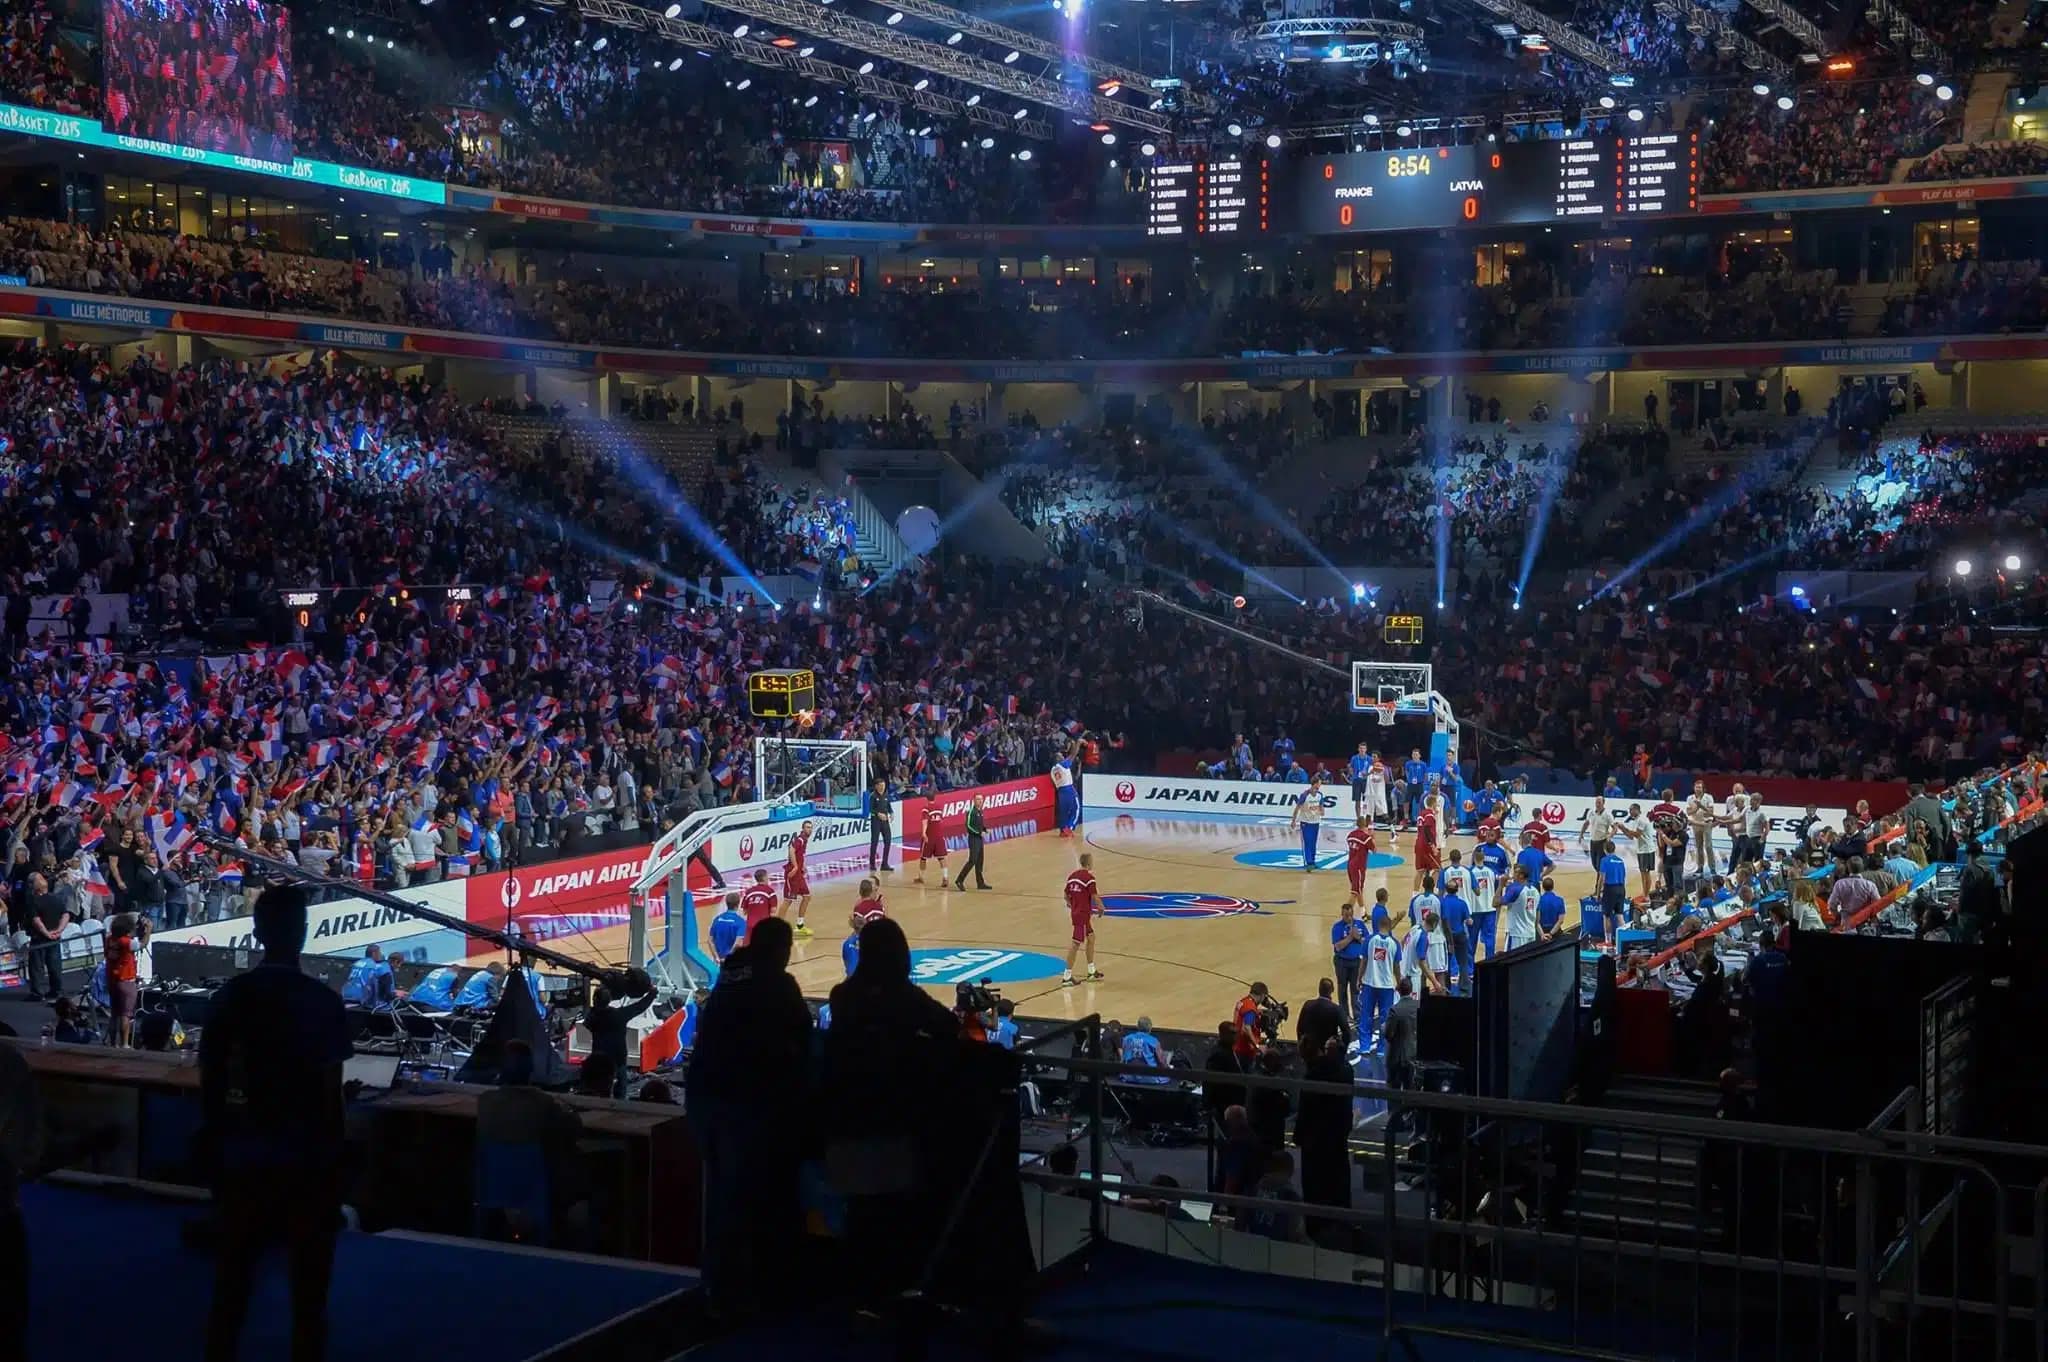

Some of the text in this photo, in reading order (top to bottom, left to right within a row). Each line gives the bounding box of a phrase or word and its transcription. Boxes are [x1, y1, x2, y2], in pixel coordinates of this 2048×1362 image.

[54, 117, 80, 137] 2015
[292, 162, 313, 177] 2015
[1388, 155, 1430, 177] 8:54
[1492, 155, 1500, 168] 0
[1325, 165, 1333, 178] 0
[391, 178, 411, 195] 2015
[1335, 187, 1374, 198] FRANCE
[1450, 180, 1483, 192] LATVIA
[1341, 205, 1352, 225] 0
[1464, 198, 1477, 219] 0
[71, 303, 96, 318] LILLE
[323, 327, 344, 341] LILLE
[1821, 346, 1849, 360] LILLE
[1525, 357, 1549, 368] LILLE
[300, 610, 308, 627] 0
[942, 786, 1038, 818] JAPA AIRLINES
[1145, 787, 1338, 808] JAPAN AIRLINS
[813, 819, 870, 842] AIRLINE
[528, 868, 594, 898] JAPAN
